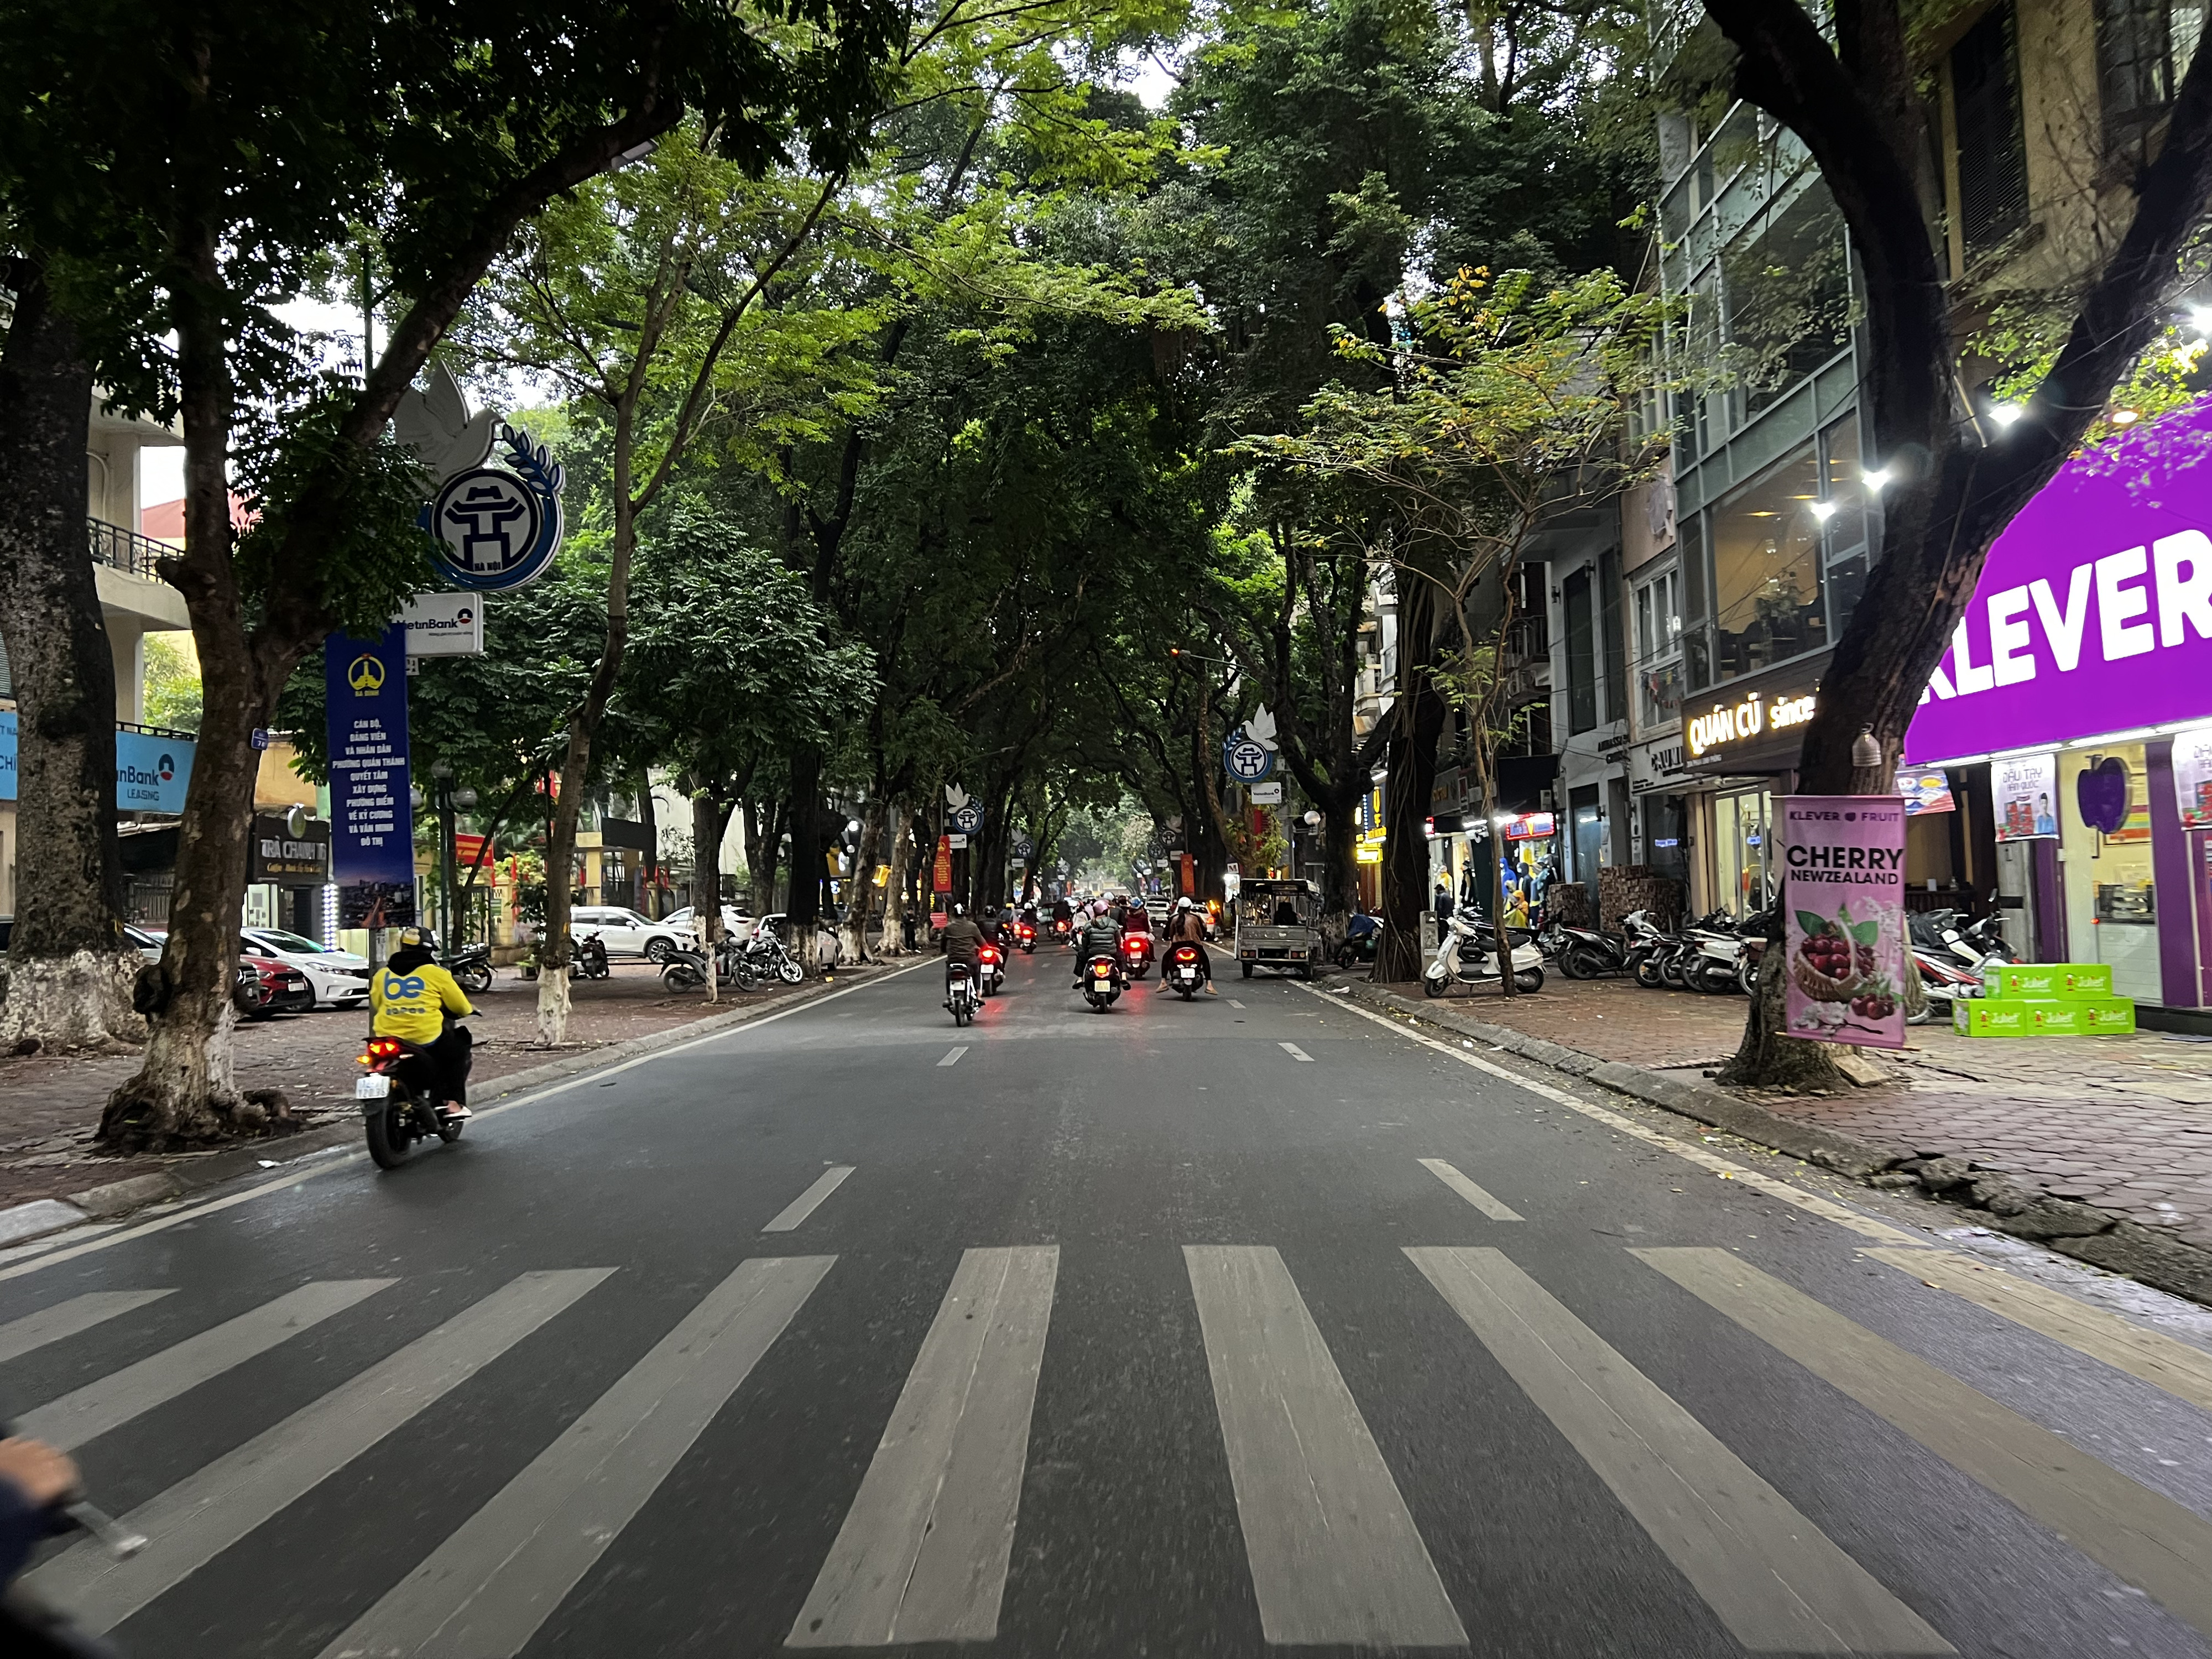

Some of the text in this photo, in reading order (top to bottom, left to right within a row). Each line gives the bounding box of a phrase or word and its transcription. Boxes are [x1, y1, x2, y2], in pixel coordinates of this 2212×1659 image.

[1689, 704, 1735, 755] QUÁN
[1770, 696, 1815, 729] since
[1789, 811, 1899, 821] KLEVER FRUIT
[260, 835, 281, 858] TRÀ
[1787, 845, 1904, 869] CHERRY
[1791, 869, 1899, 885] NEWZEALAND
[384, 971, 425, 1000] be
